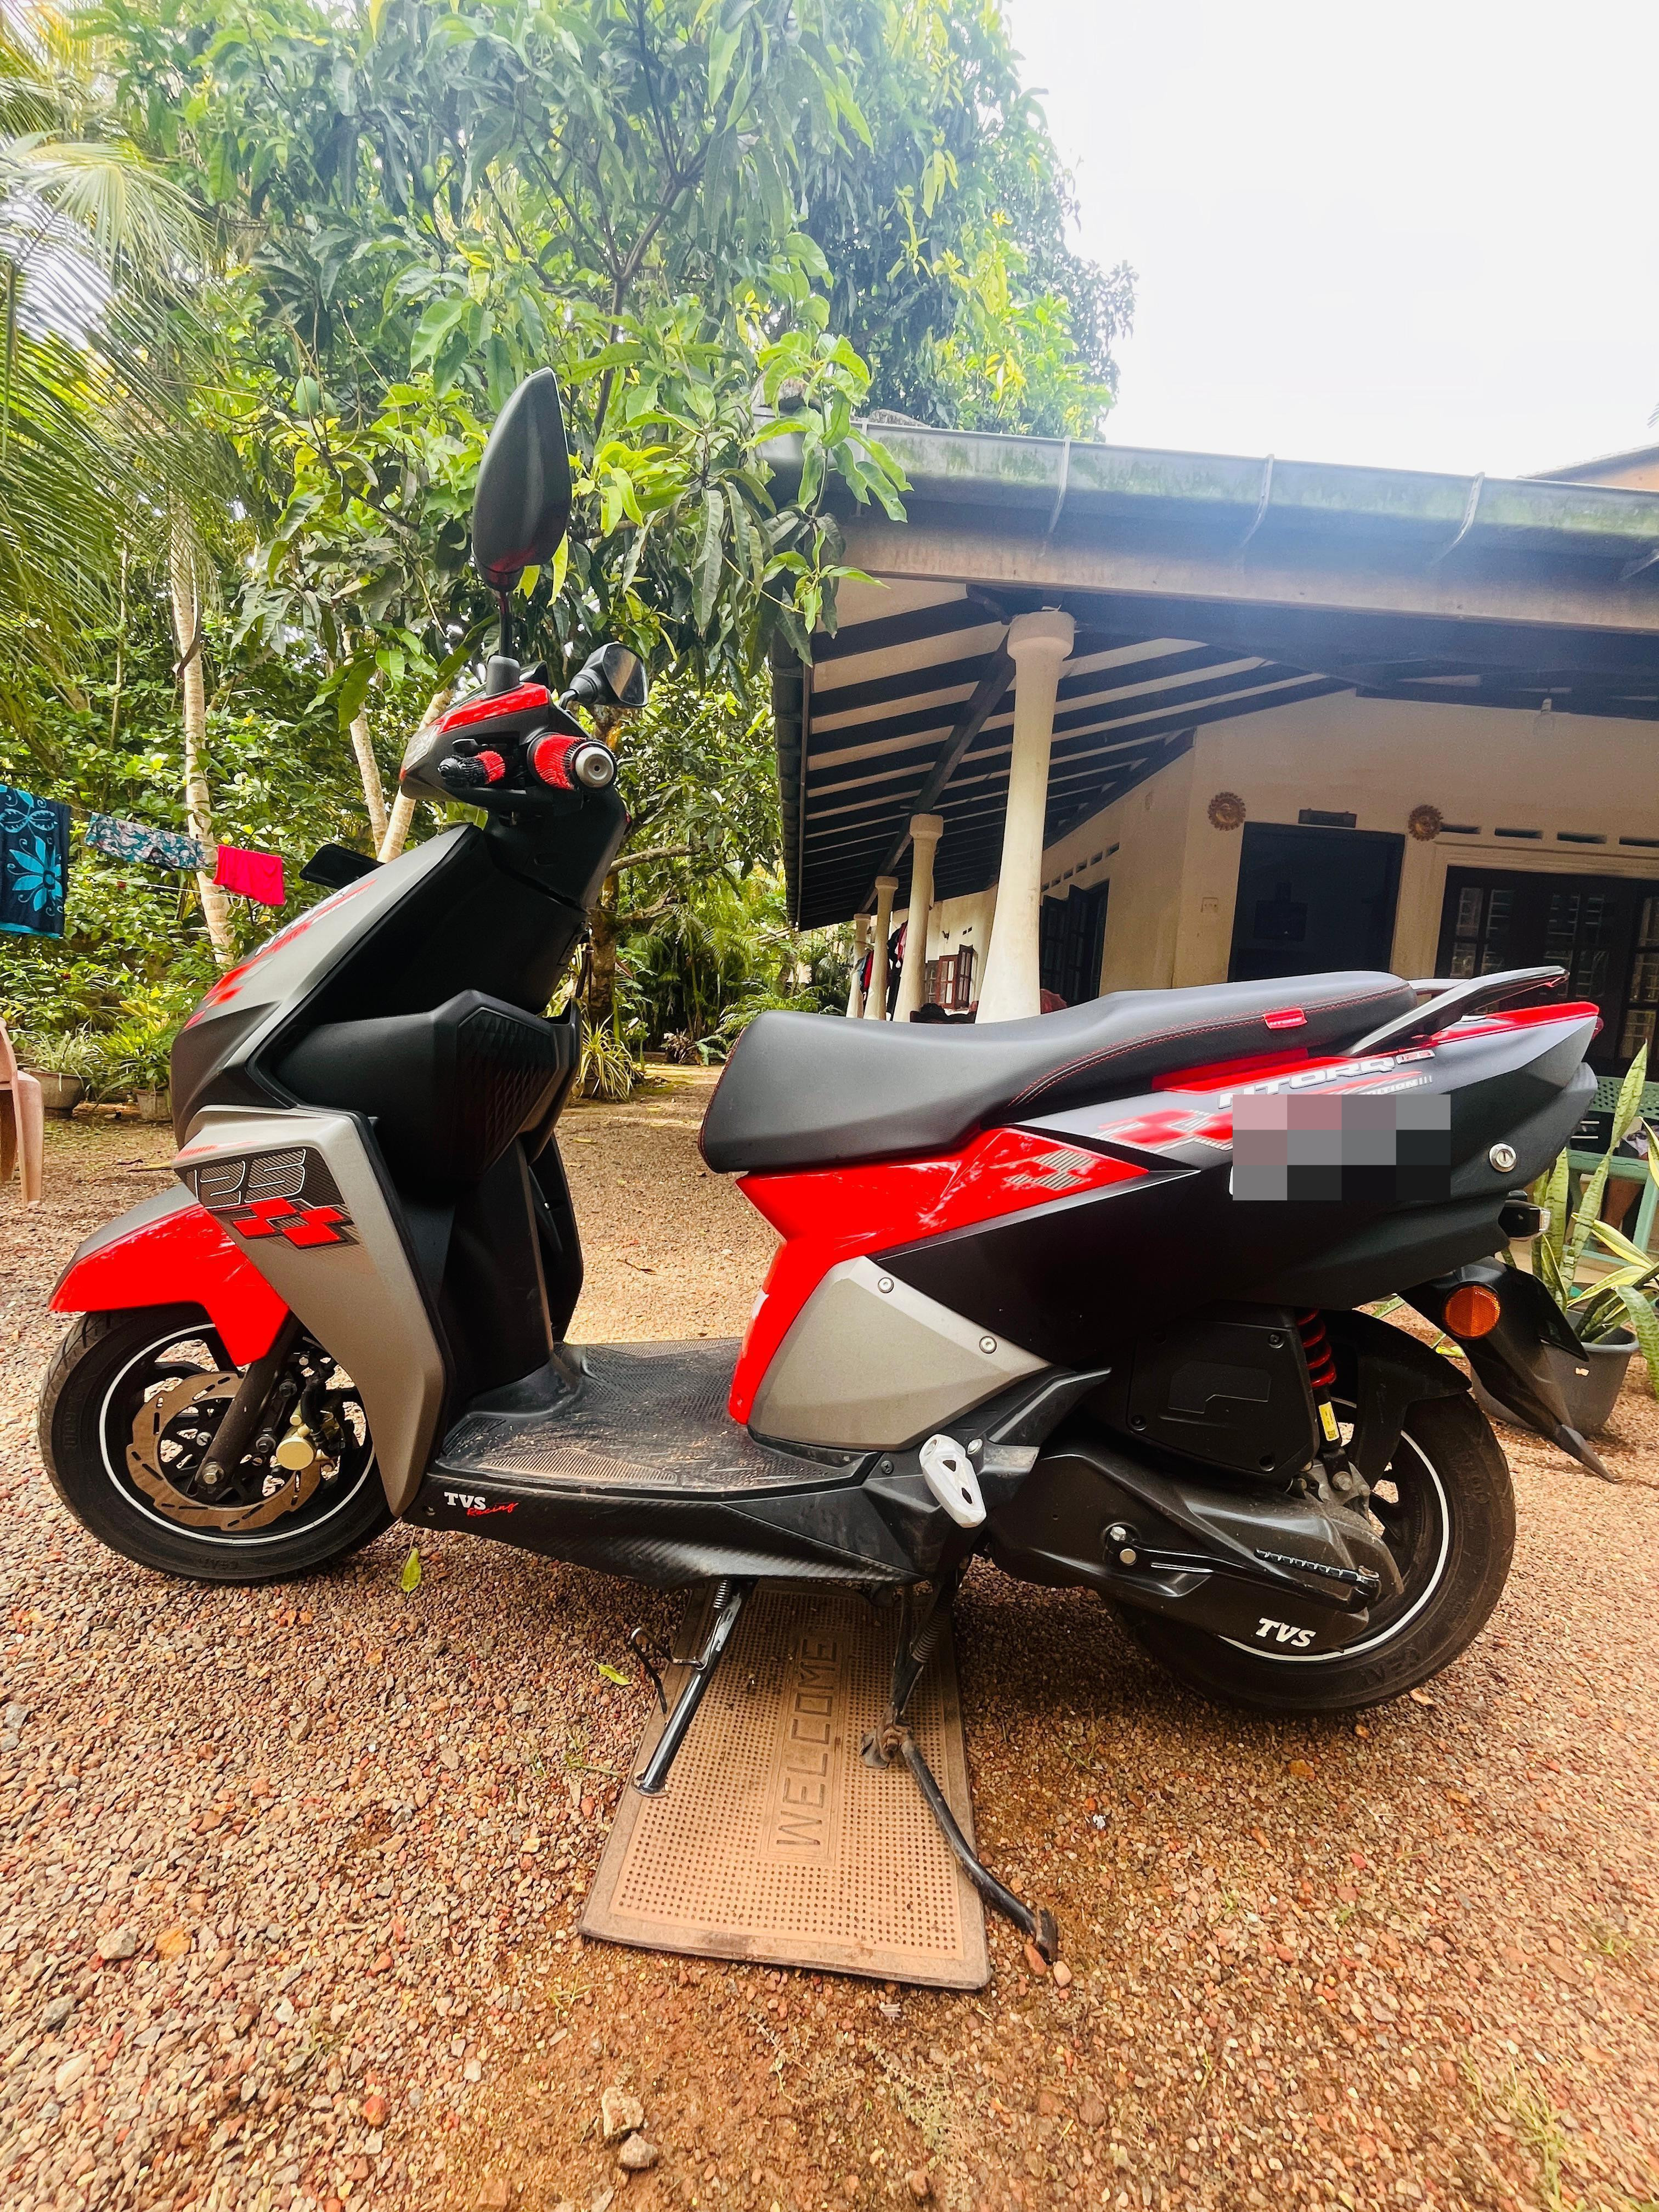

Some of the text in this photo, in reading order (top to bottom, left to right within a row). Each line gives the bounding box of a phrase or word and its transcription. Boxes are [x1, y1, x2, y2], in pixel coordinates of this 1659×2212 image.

[444, 1491, 520, 1517] TVS Racing
[1255, 1617, 1317, 1647] TVS
[776, 1638, 837, 1846] WELCOME
